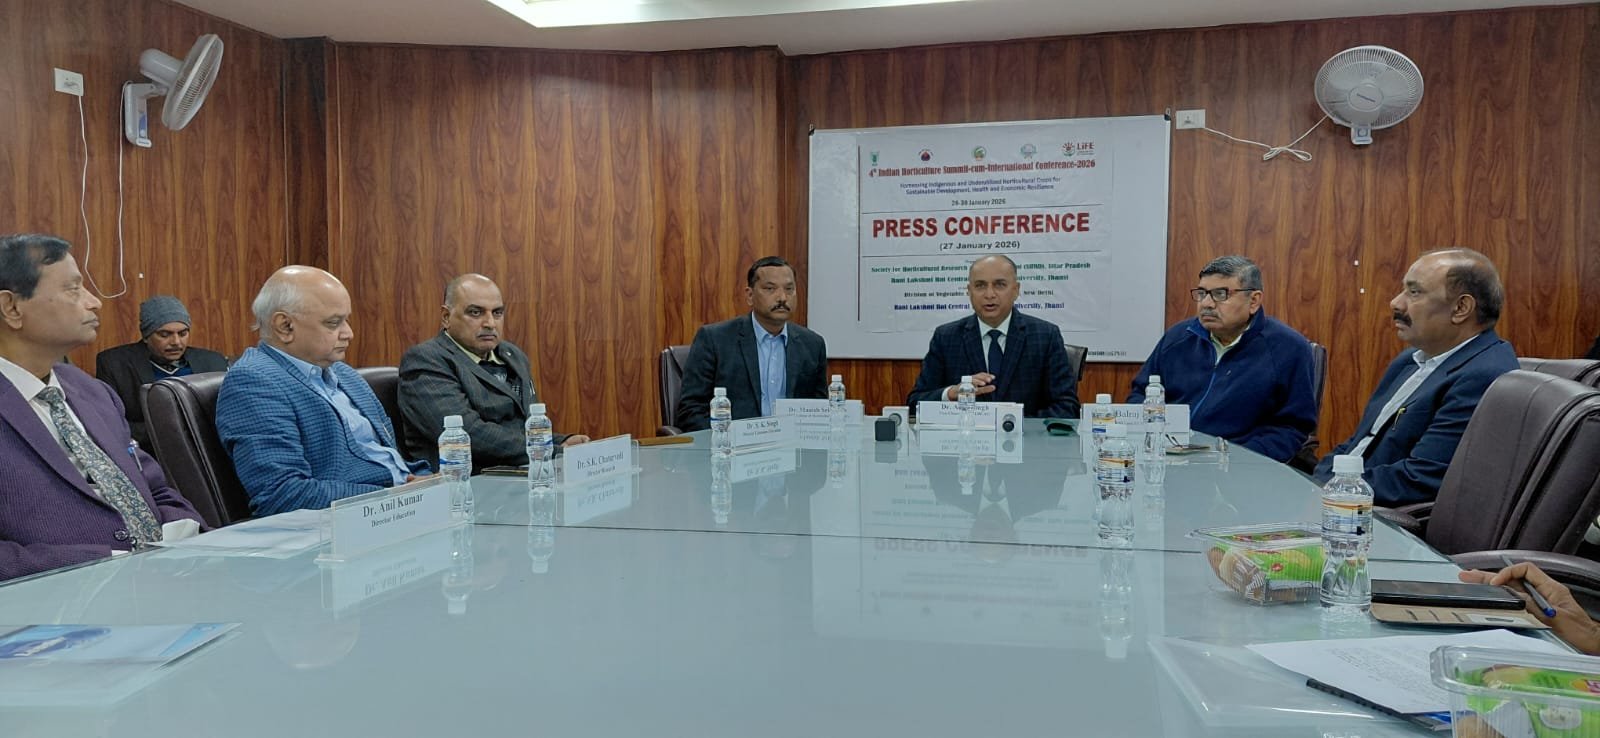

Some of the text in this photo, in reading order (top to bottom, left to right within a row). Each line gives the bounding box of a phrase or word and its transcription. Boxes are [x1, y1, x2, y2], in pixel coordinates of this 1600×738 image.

[1077, 142, 1095, 150] LiFE
[878, 168, 900, 177] Indian
[902, 166, 942, 176] Horticulture
[1035, 159, 1096, 169] Conference-2026
[872, 212, 1090, 238] PRESS CONFERENCE
[939, 240, 1020, 251] (27 January 2026)
[363, 493, 424, 518] Dr. Anil Kumar
[371, 516, 392, 528] Director
